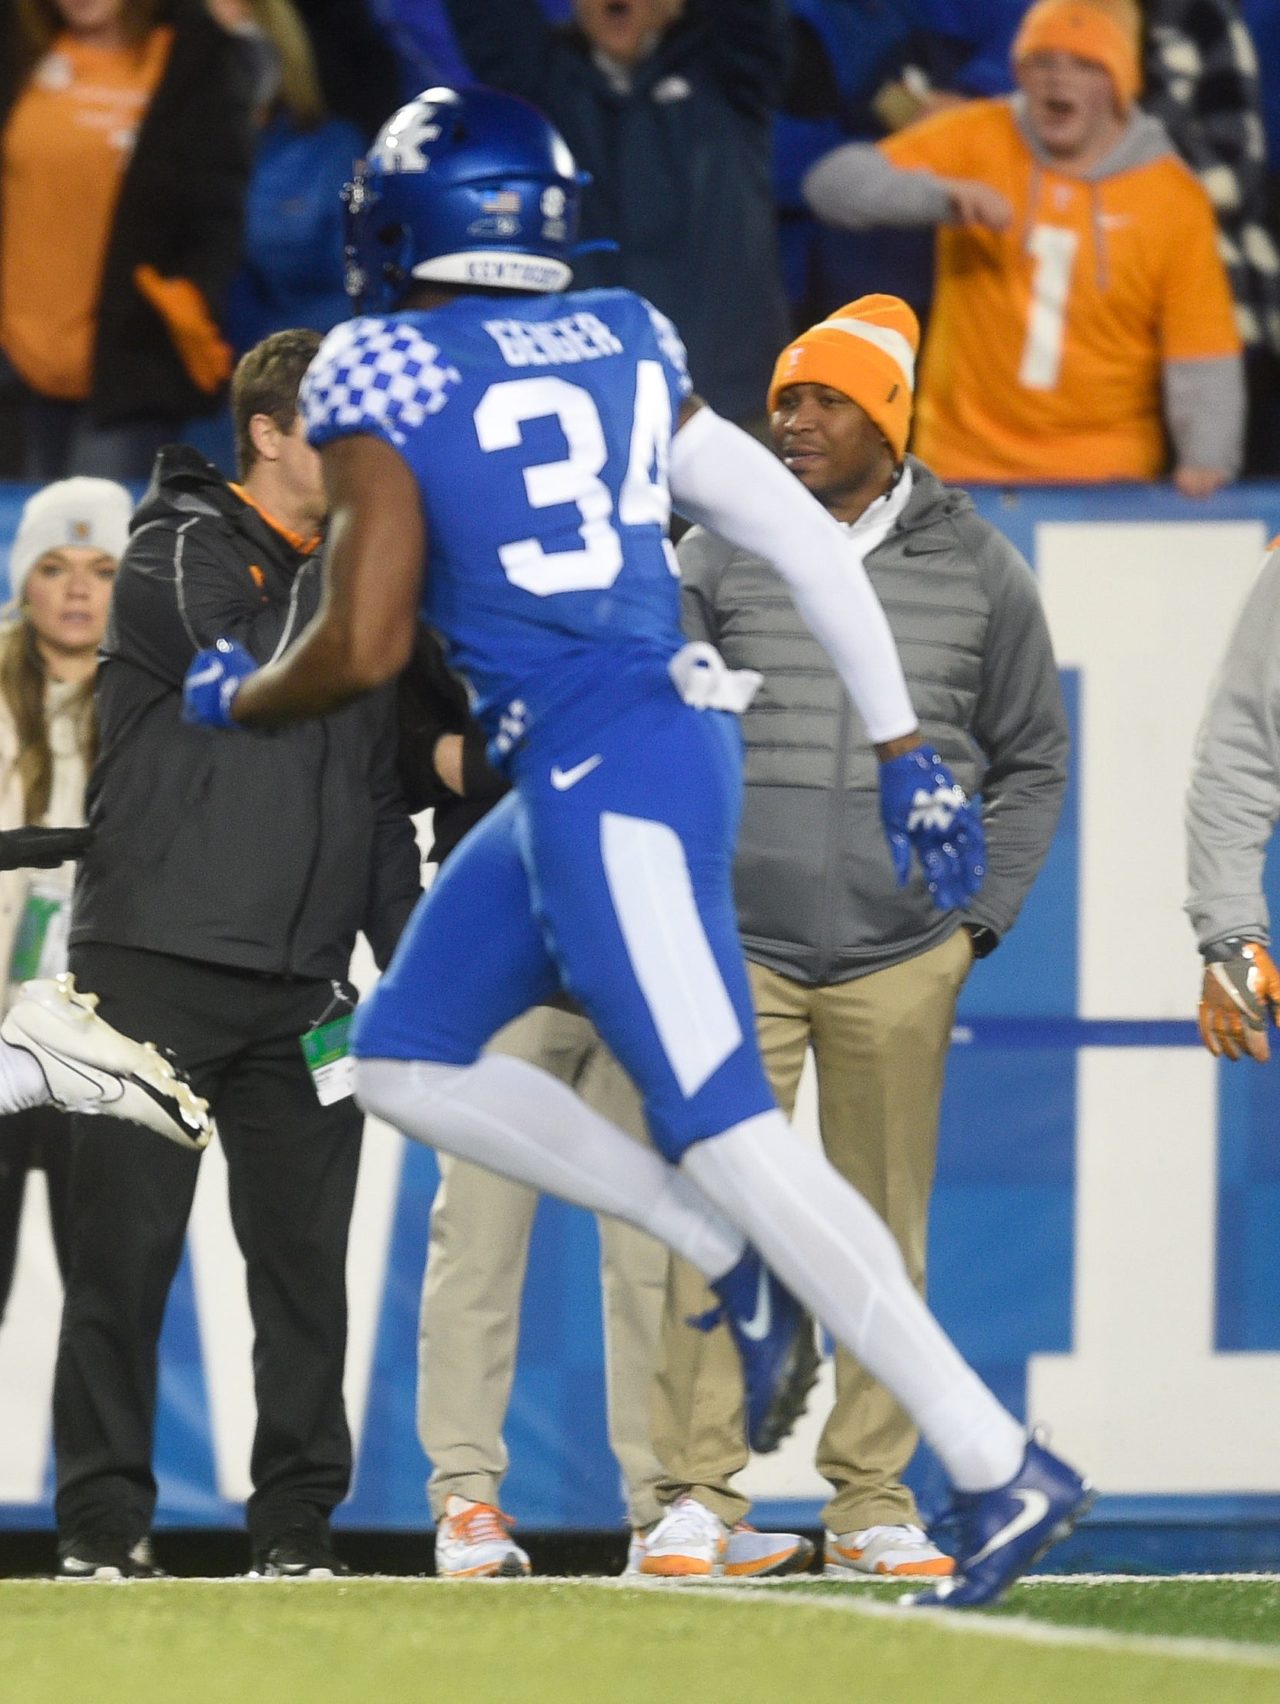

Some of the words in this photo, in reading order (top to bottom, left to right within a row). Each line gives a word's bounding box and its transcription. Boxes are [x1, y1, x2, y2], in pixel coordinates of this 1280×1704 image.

[481, 311, 624, 368] GEIGER
[1018, 222, 1080, 392] 1
[473, 359, 681, 597] 34
